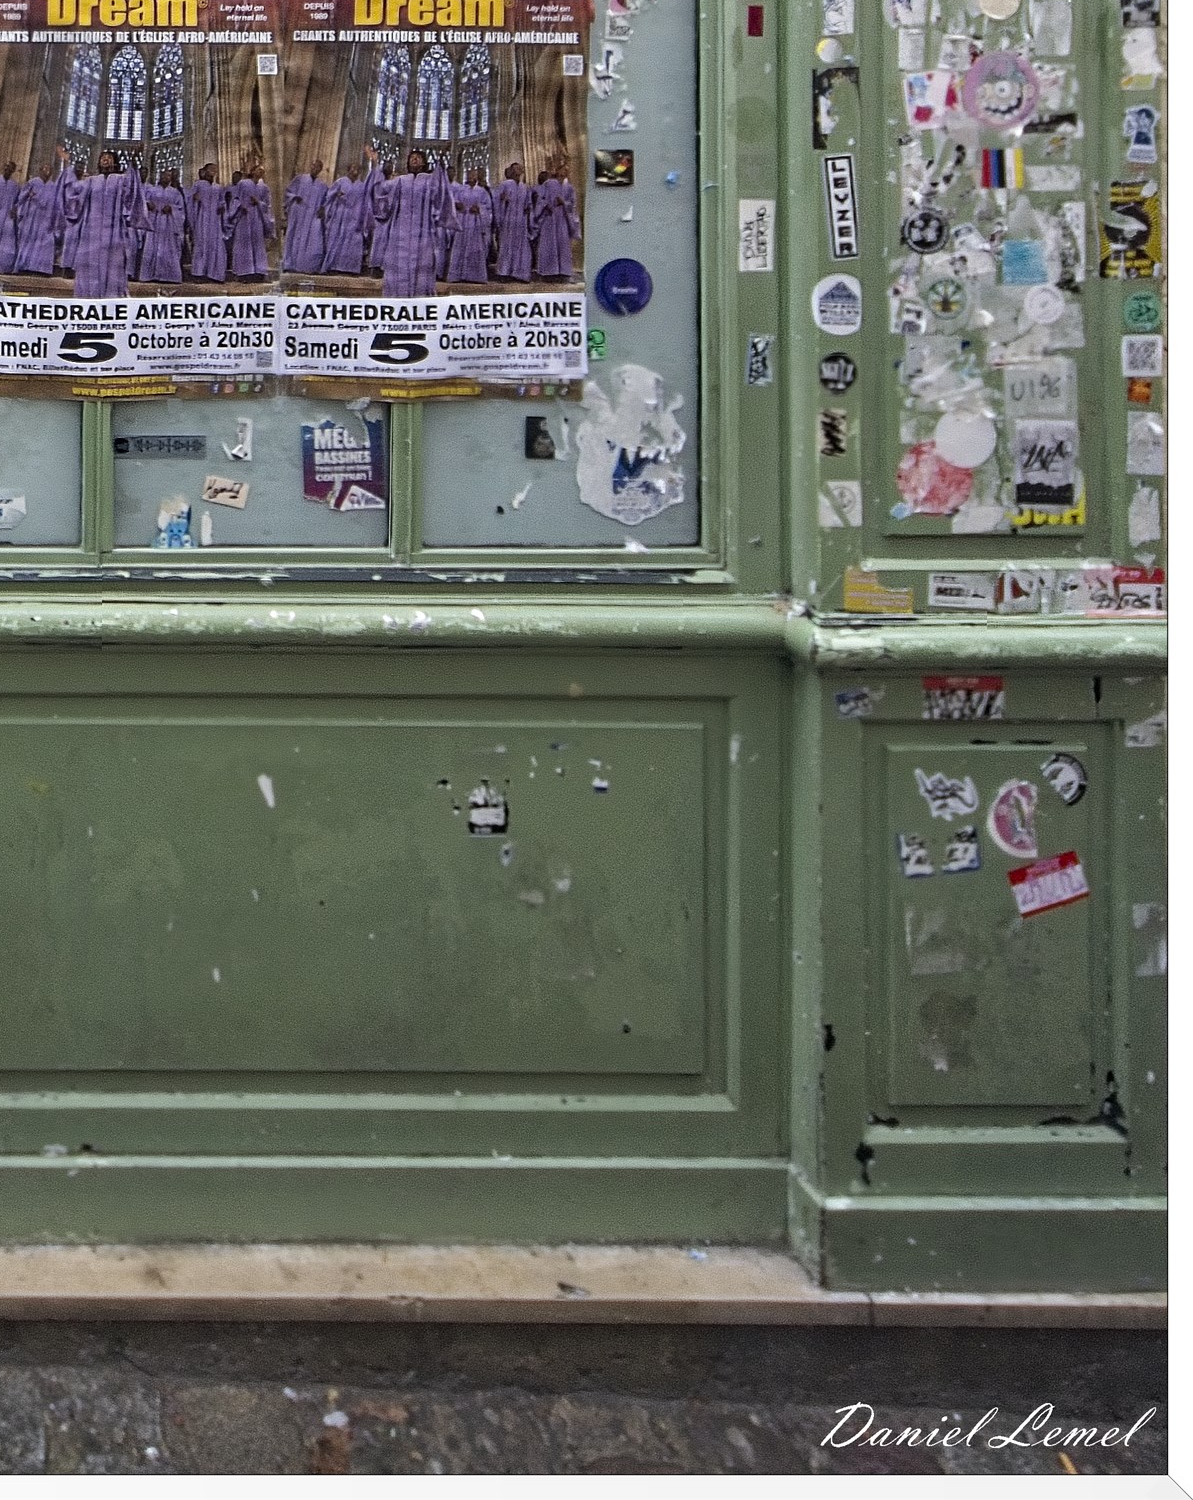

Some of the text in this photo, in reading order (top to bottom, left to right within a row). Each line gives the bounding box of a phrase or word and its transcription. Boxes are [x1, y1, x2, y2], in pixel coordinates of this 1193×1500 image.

[304, 2, 335, 11] DEPUIS
[32, 30, 112, 45] AUTHENTIQUES
[116, 30, 131, 43] DE
[179, 28, 273, 44] AFRO-AMÉRICAINE
[293, 29, 336, 42] CHANTS
[339, 30, 420, 45] AUTHENTIQUES
[424, 30, 437, 43] DE
[485, 28, 579, 45] AFRO-AMÉRICAINE
[135, 302, 276, 320] AMERICAINE
[286, 300, 582, 322] CATHEDRALE AMERICAINE
[100, 323, 127, 331] PARIS
[56, 332, 119, 364] 5
[128, 332, 194, 350] Octobre
[199, 330, 211, 348] à
[216, 330, 275, 349] 20h30
[284, 336, 358, 359] Samedi
[368, 332, 430, 365] 5
[439, 333, 502, 350] Octobre
[507, 331, 518, 348] à
[524, 330, 582, 348] 20h30
